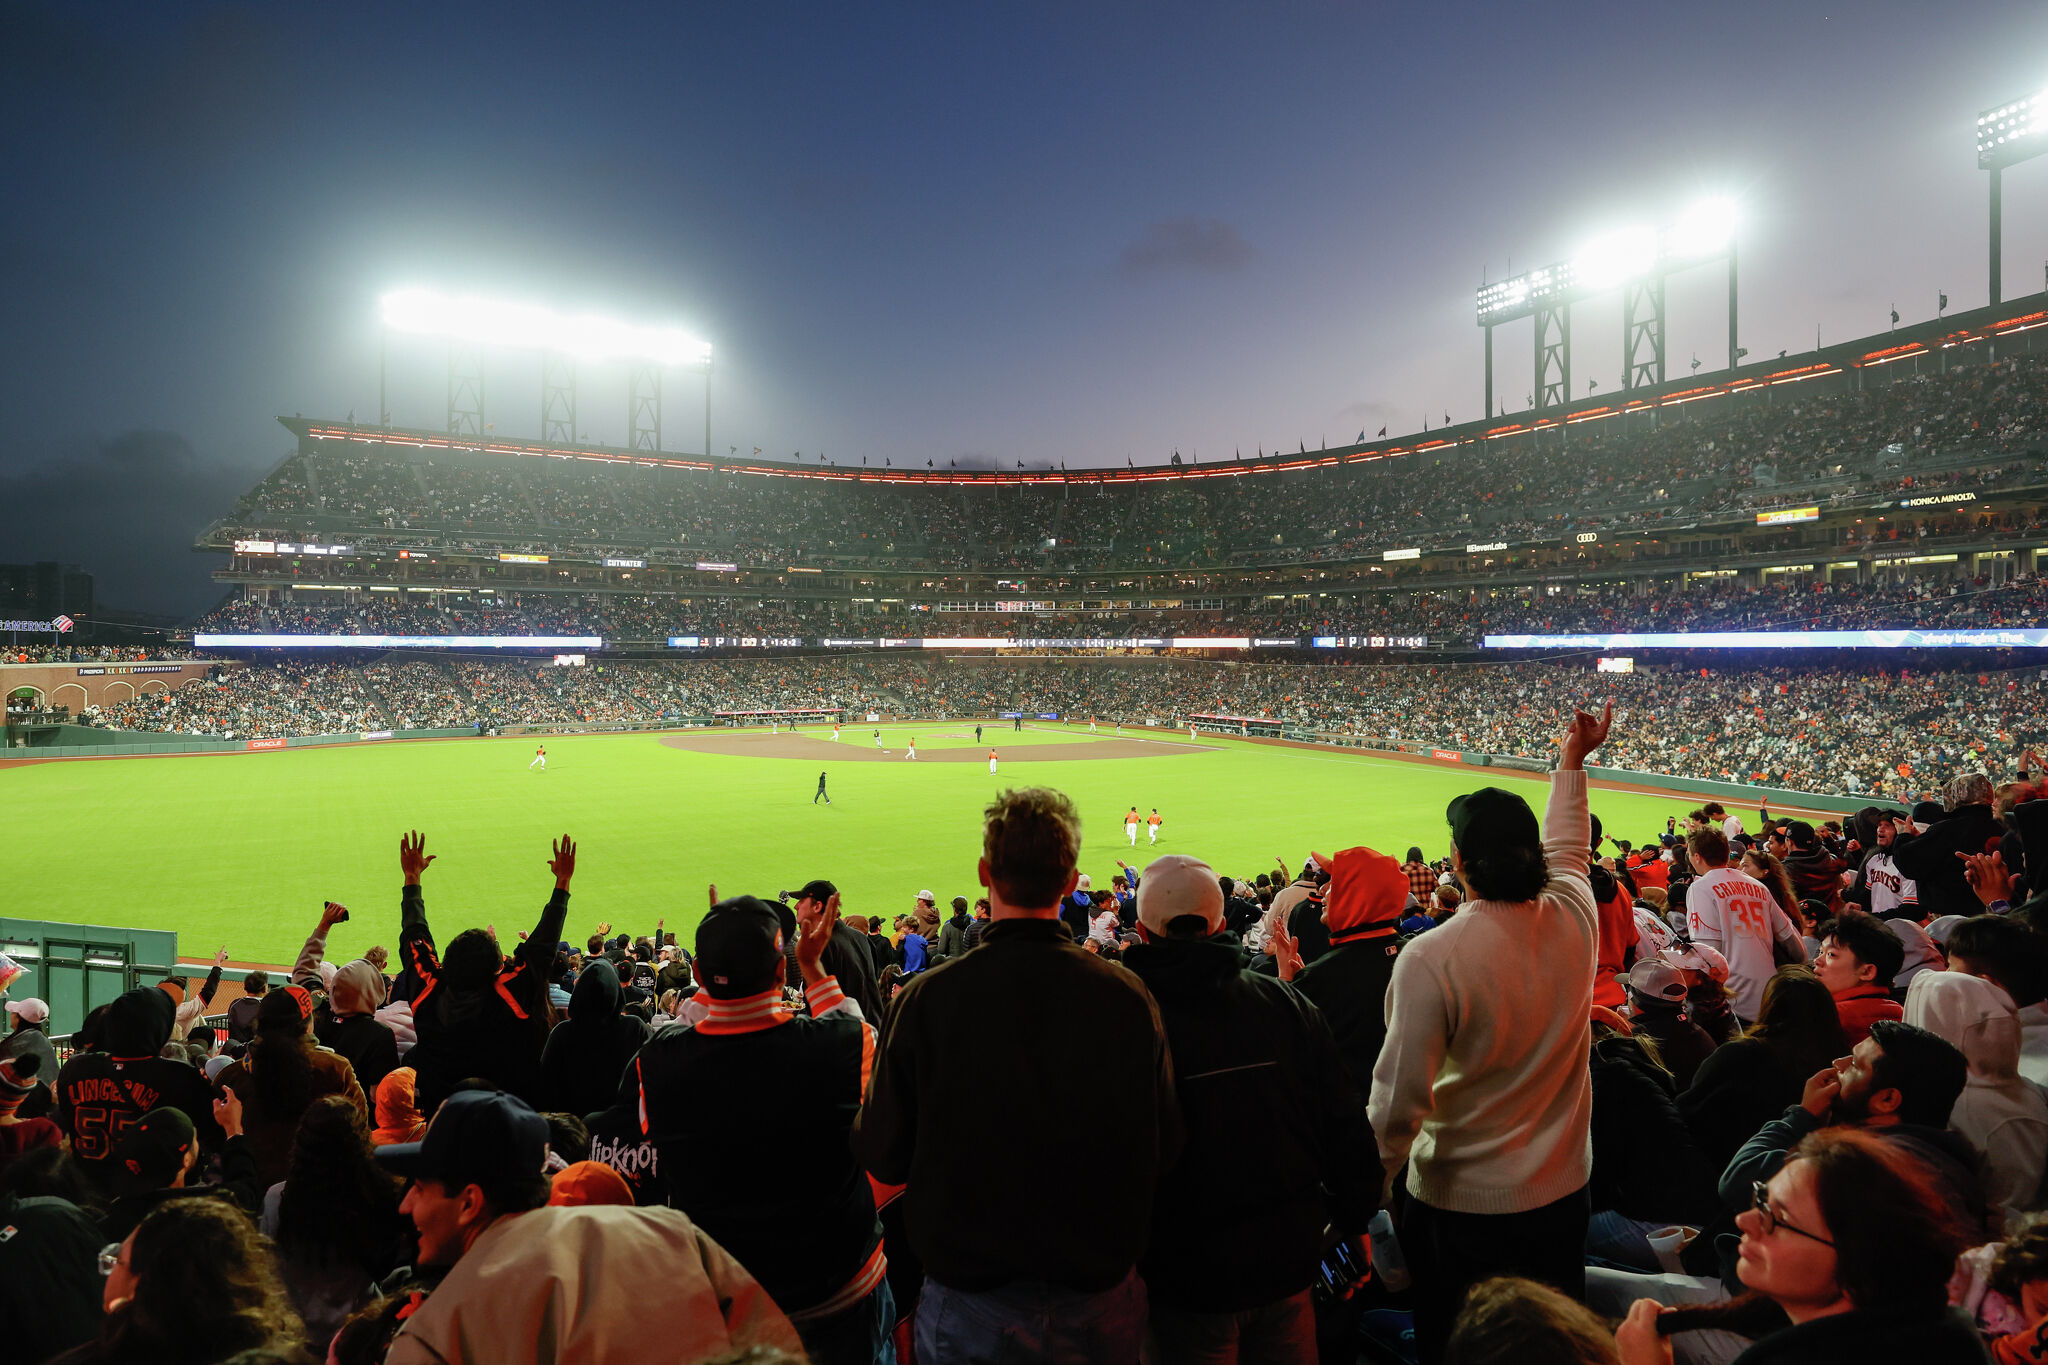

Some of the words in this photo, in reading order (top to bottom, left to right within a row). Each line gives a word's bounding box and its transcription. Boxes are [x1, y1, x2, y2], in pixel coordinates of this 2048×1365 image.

[1910, 496, 1940, 507] KONICA
[1941, 492, 1976, 503] MINOLTA
[607, 559, 643, 568] CUTWATER
[4, 620, 52, 632] AMERICA
[1955, 632, 1998, 645] Imagine
[1999, 632, 2025, 643] That
[252, 740, 282, 748] ORACLE
[1436, 751, 1457, 760] ORACLE
[1870, 869, 1901, 893] IANTS
[1712, 881, 1768, 901] CRAWFORD
[1729, 899, 1768, 940] 35
[589, 1134, 658, 1178] lipkno
